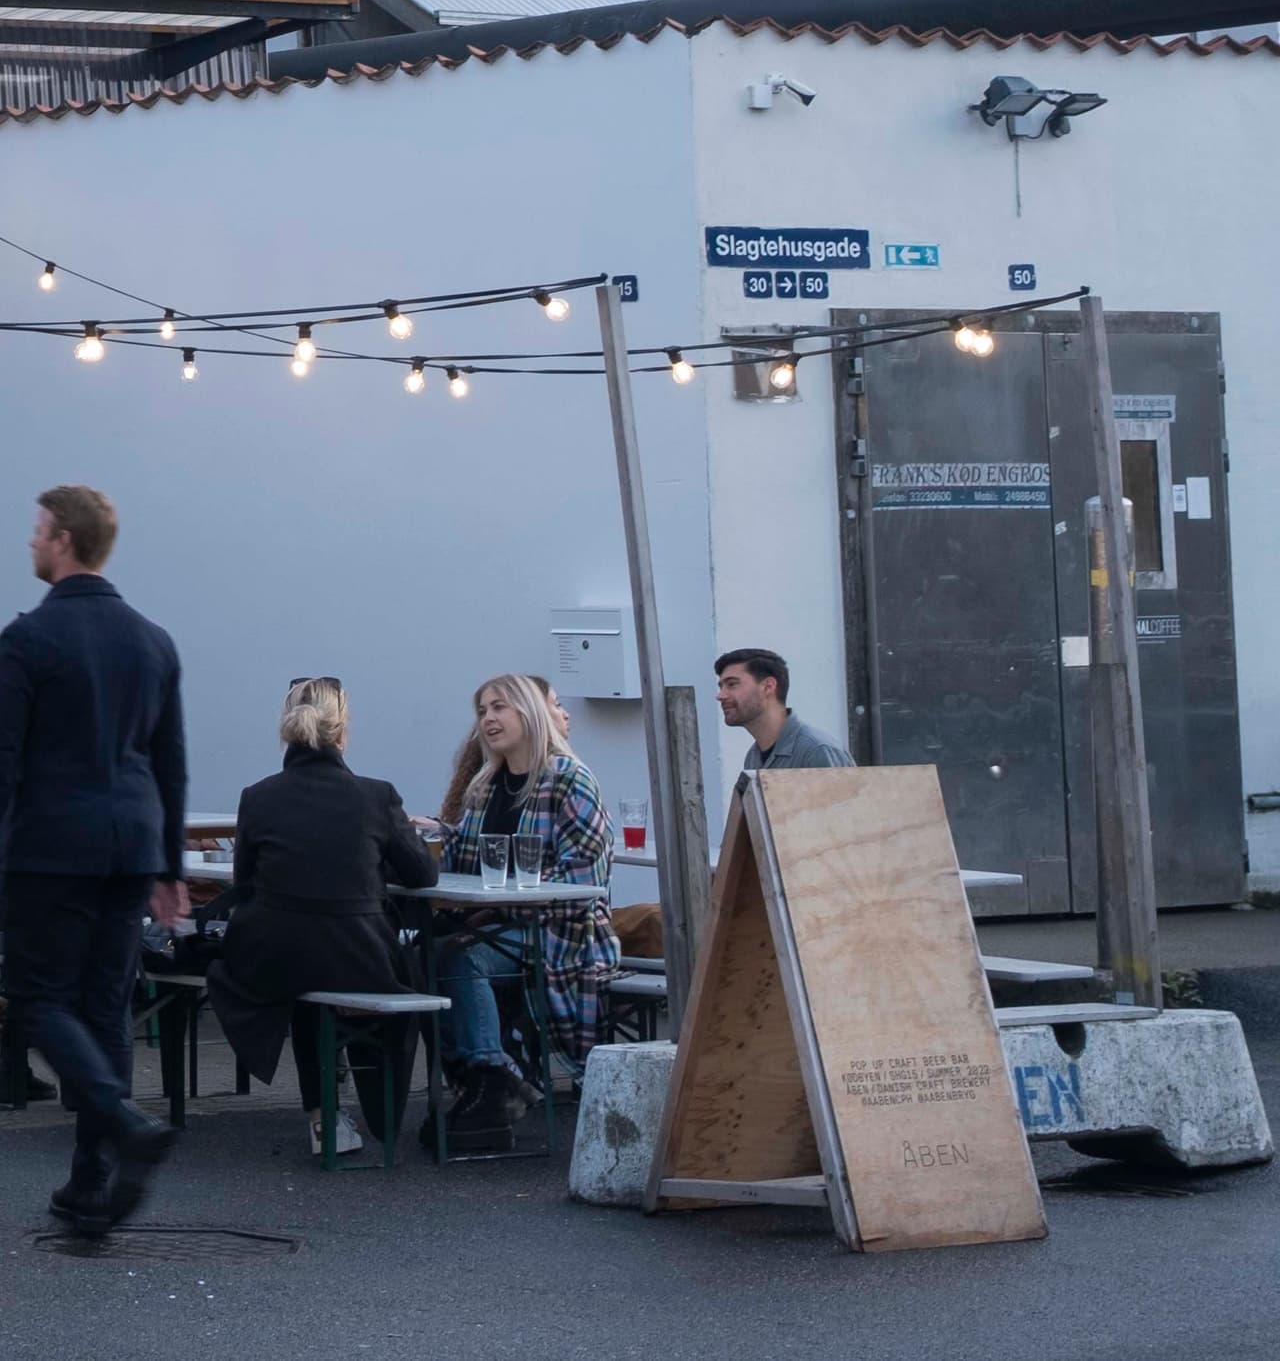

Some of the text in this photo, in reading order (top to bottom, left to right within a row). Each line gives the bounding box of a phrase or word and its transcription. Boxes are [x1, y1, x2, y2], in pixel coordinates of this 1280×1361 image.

[716, 234, 860, 261] Slagtehusgade
[1014, 270, 1030, 284] 50
[618, 281, 632, 296] 15
[749, 278, 823, 292] 30 50
[947, 465, 981, 484] KØD
[850, 1054, 970, 1070] POP UP CRAFT BEER BAR
[916, 1079, 944, 1091] CRAFT
[950, 1077, 991, 1088] BREWERY
[902, 1140, 969, 1167] ÅBEN
